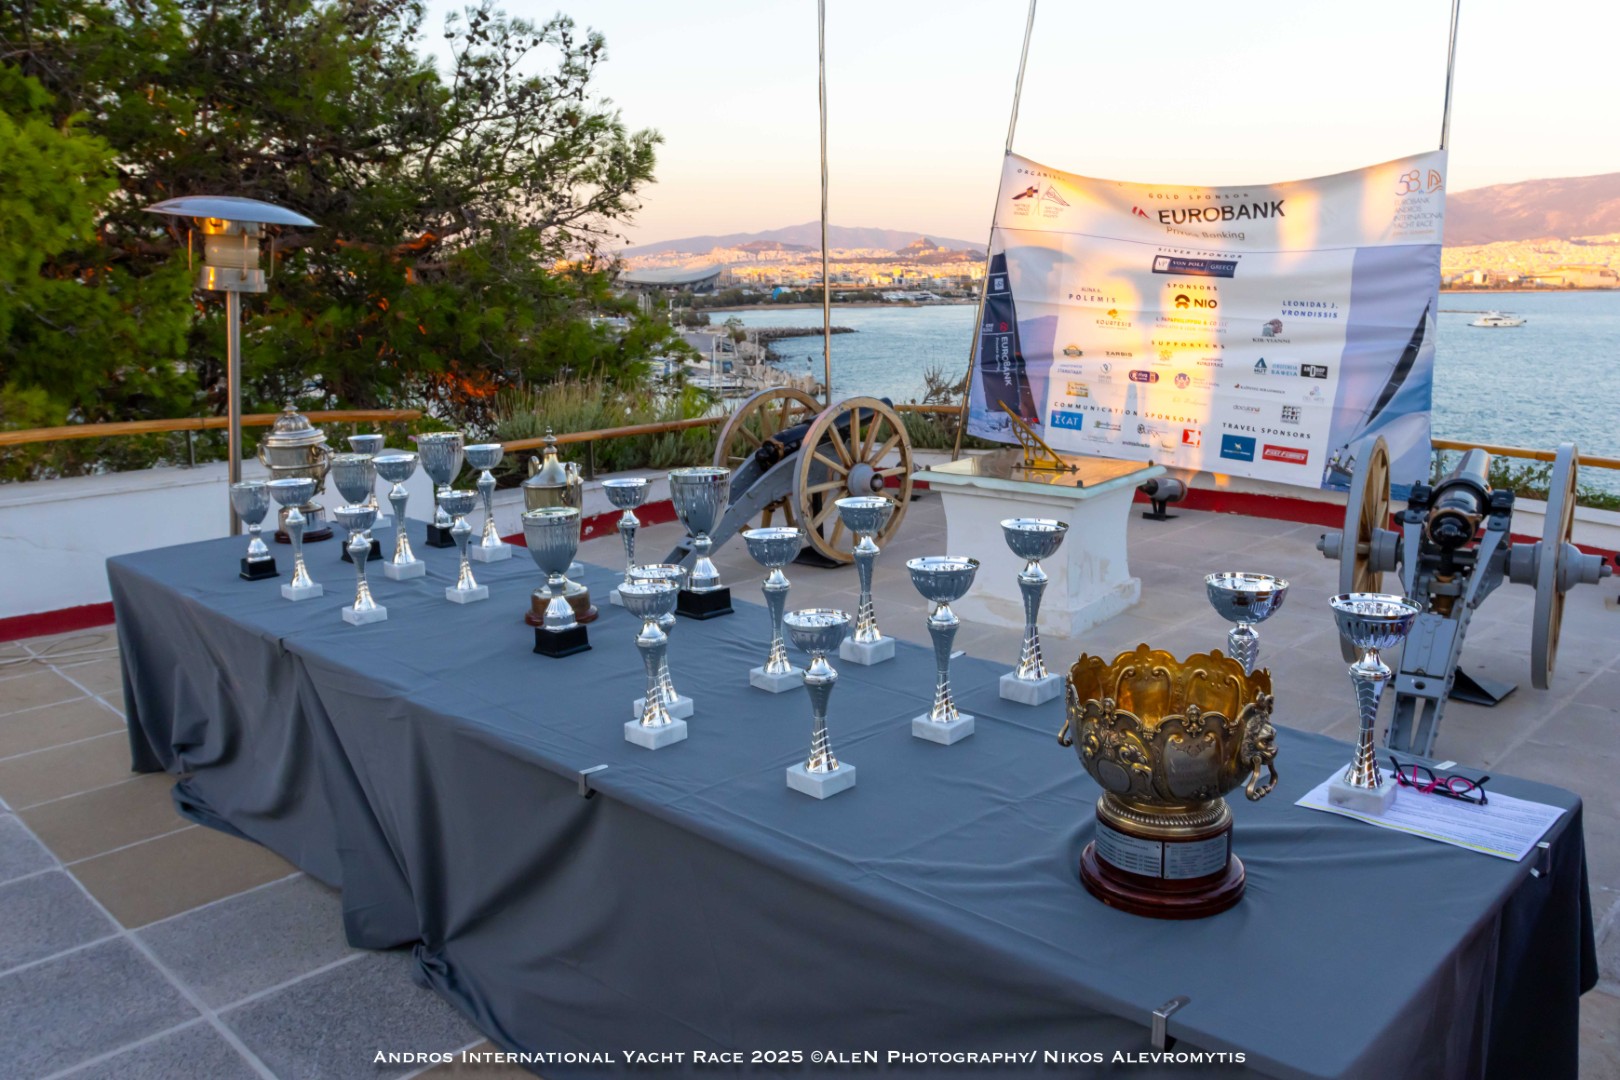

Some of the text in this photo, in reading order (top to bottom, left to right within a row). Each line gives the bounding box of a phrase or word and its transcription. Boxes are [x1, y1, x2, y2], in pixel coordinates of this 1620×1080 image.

[1157, 199, 1286, 225] EUROBANK
[1202, 230, 1246, 241] Banking
[1158, 247, 1243, 259] SILVER SPONSOR
[1210, 263, 1234, 271] GREECE
[1167, 282, 1218, 291] SPONSORS
[1068, 293, 1116, 303] POLEMIS
[1194, 298, 1218, 309] NIO
[1282, 300, 1327, 308] LEONIDAS
[1281, 309, 1338, 318] VRONDISSIS
[1151, 340, 1225, 349] SUPPORTERS
[1001, 336, 1012, 387] EUROBANK
[1054, 401, 1198, 424] COMMUNICATION SPONSORS
[1222, 422, 1311, 439] TRAVEL SPONSORS
